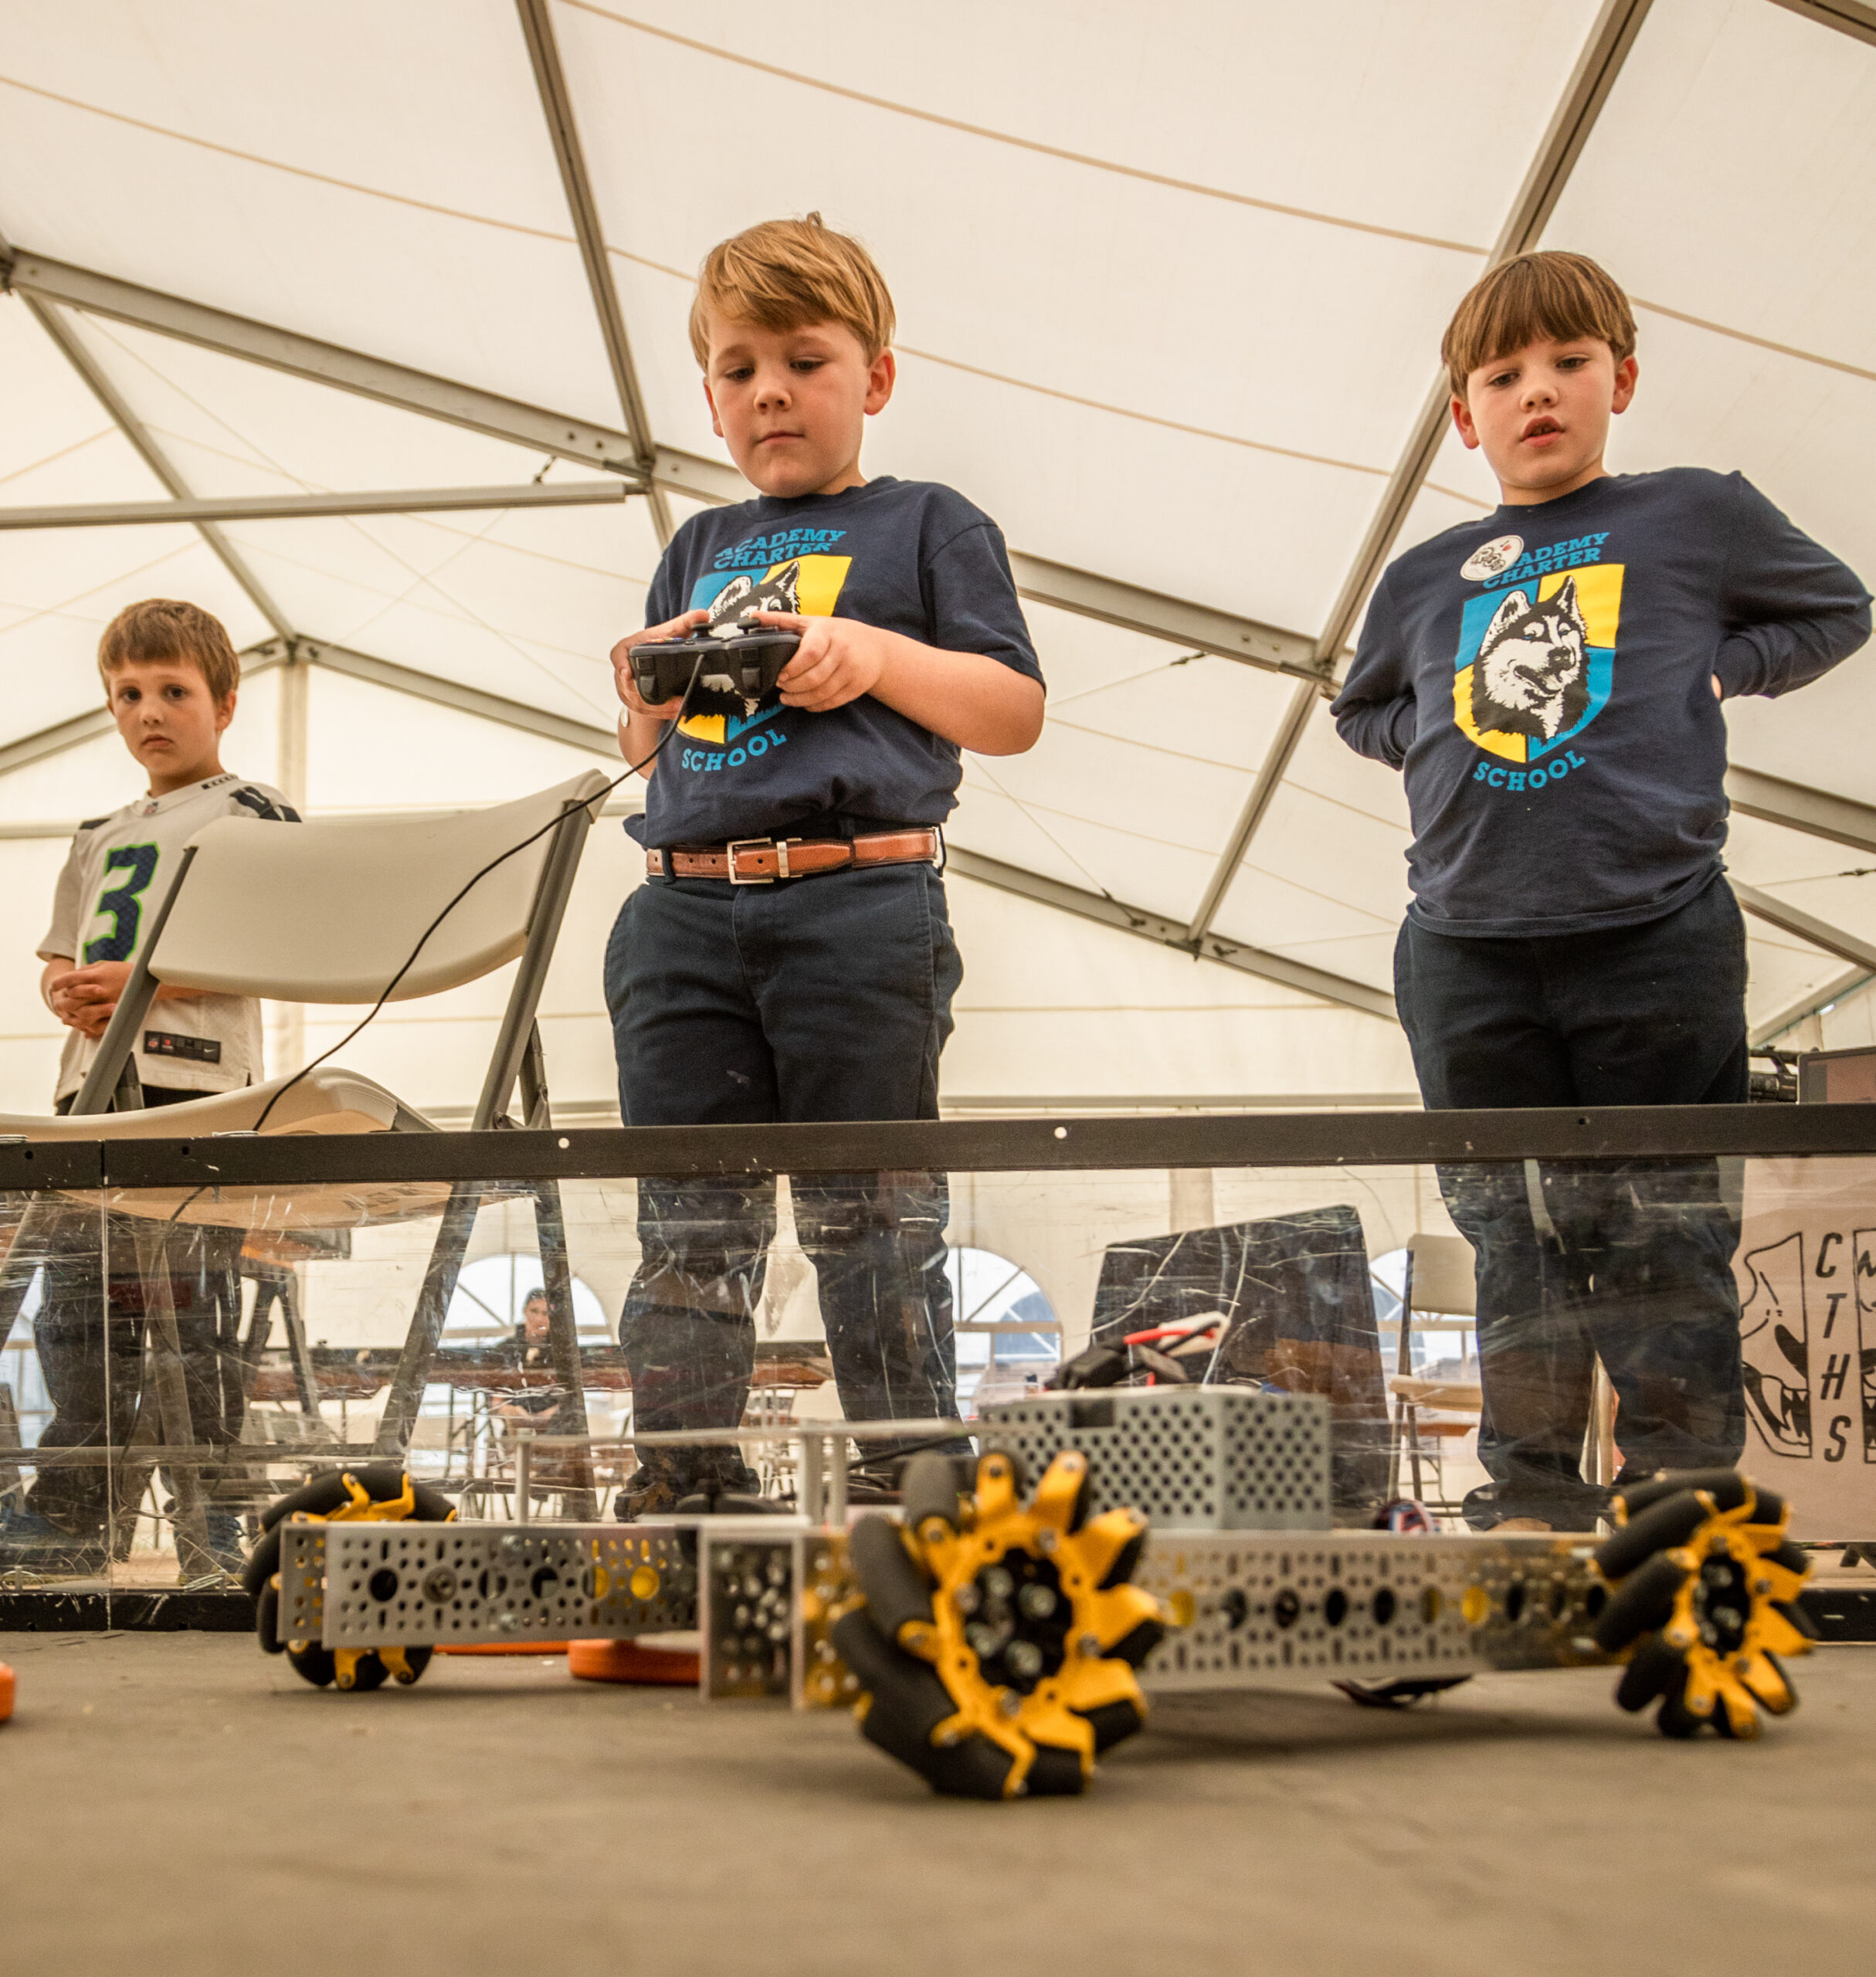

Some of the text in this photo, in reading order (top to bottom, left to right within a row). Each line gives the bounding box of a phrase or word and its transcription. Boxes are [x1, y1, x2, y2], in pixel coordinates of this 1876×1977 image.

[714, 543, 833, 569] CHARTER
[715, 528, 846, 558] ACADEMY
[1508, 531, 1610, 569] ADEMY
[1483, 548, 1601, 588] CHARTER
[682, 728, 786, 771] SCHOOL
[1474, 750, 1586, 791] SCHOOL
[82, 842, 160, 965] 3
